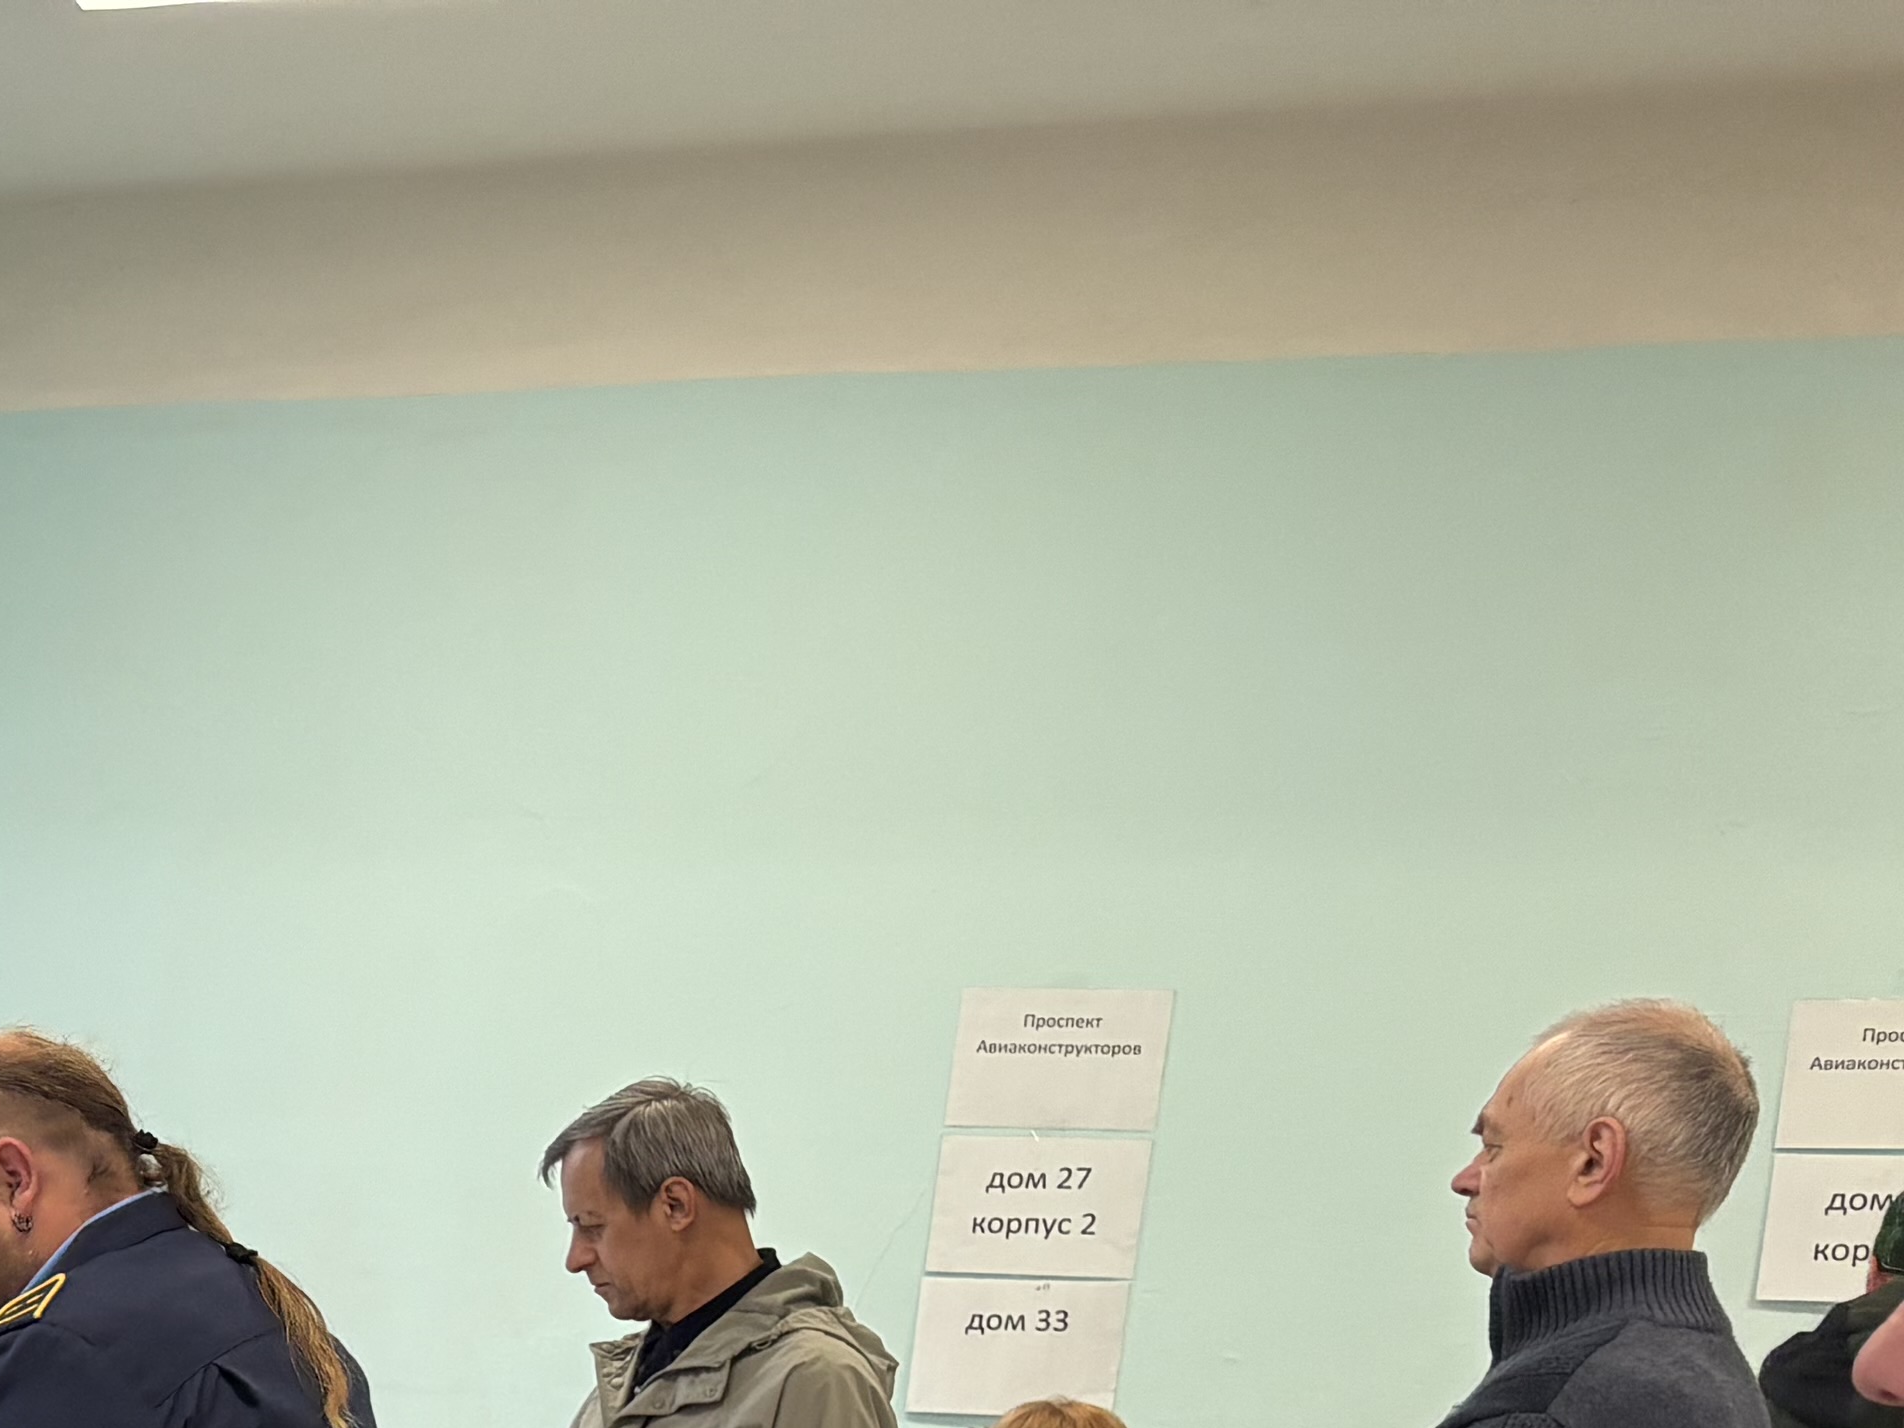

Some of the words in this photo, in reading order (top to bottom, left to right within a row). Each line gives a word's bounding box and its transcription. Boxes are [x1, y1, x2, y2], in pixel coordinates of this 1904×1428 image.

[1023, 1013, 1103, 1032] Проспект
[976, 1039, 1142, 1057] Авиаконструкторов
[985, 1171, 1047, 1193] дом
[1057, 1167, 1092, 1190] 27
[1824, 1193, 1892, 1216] дом
[971, 1216, 1071, 1239] корпус
[1080, 1213, 1097, 1236] 2
[1813, 1243, 1871, 1268] кор
[965, 1312, 1026, 1335] дом
[1035, 1310, 1069, 1332] 33
